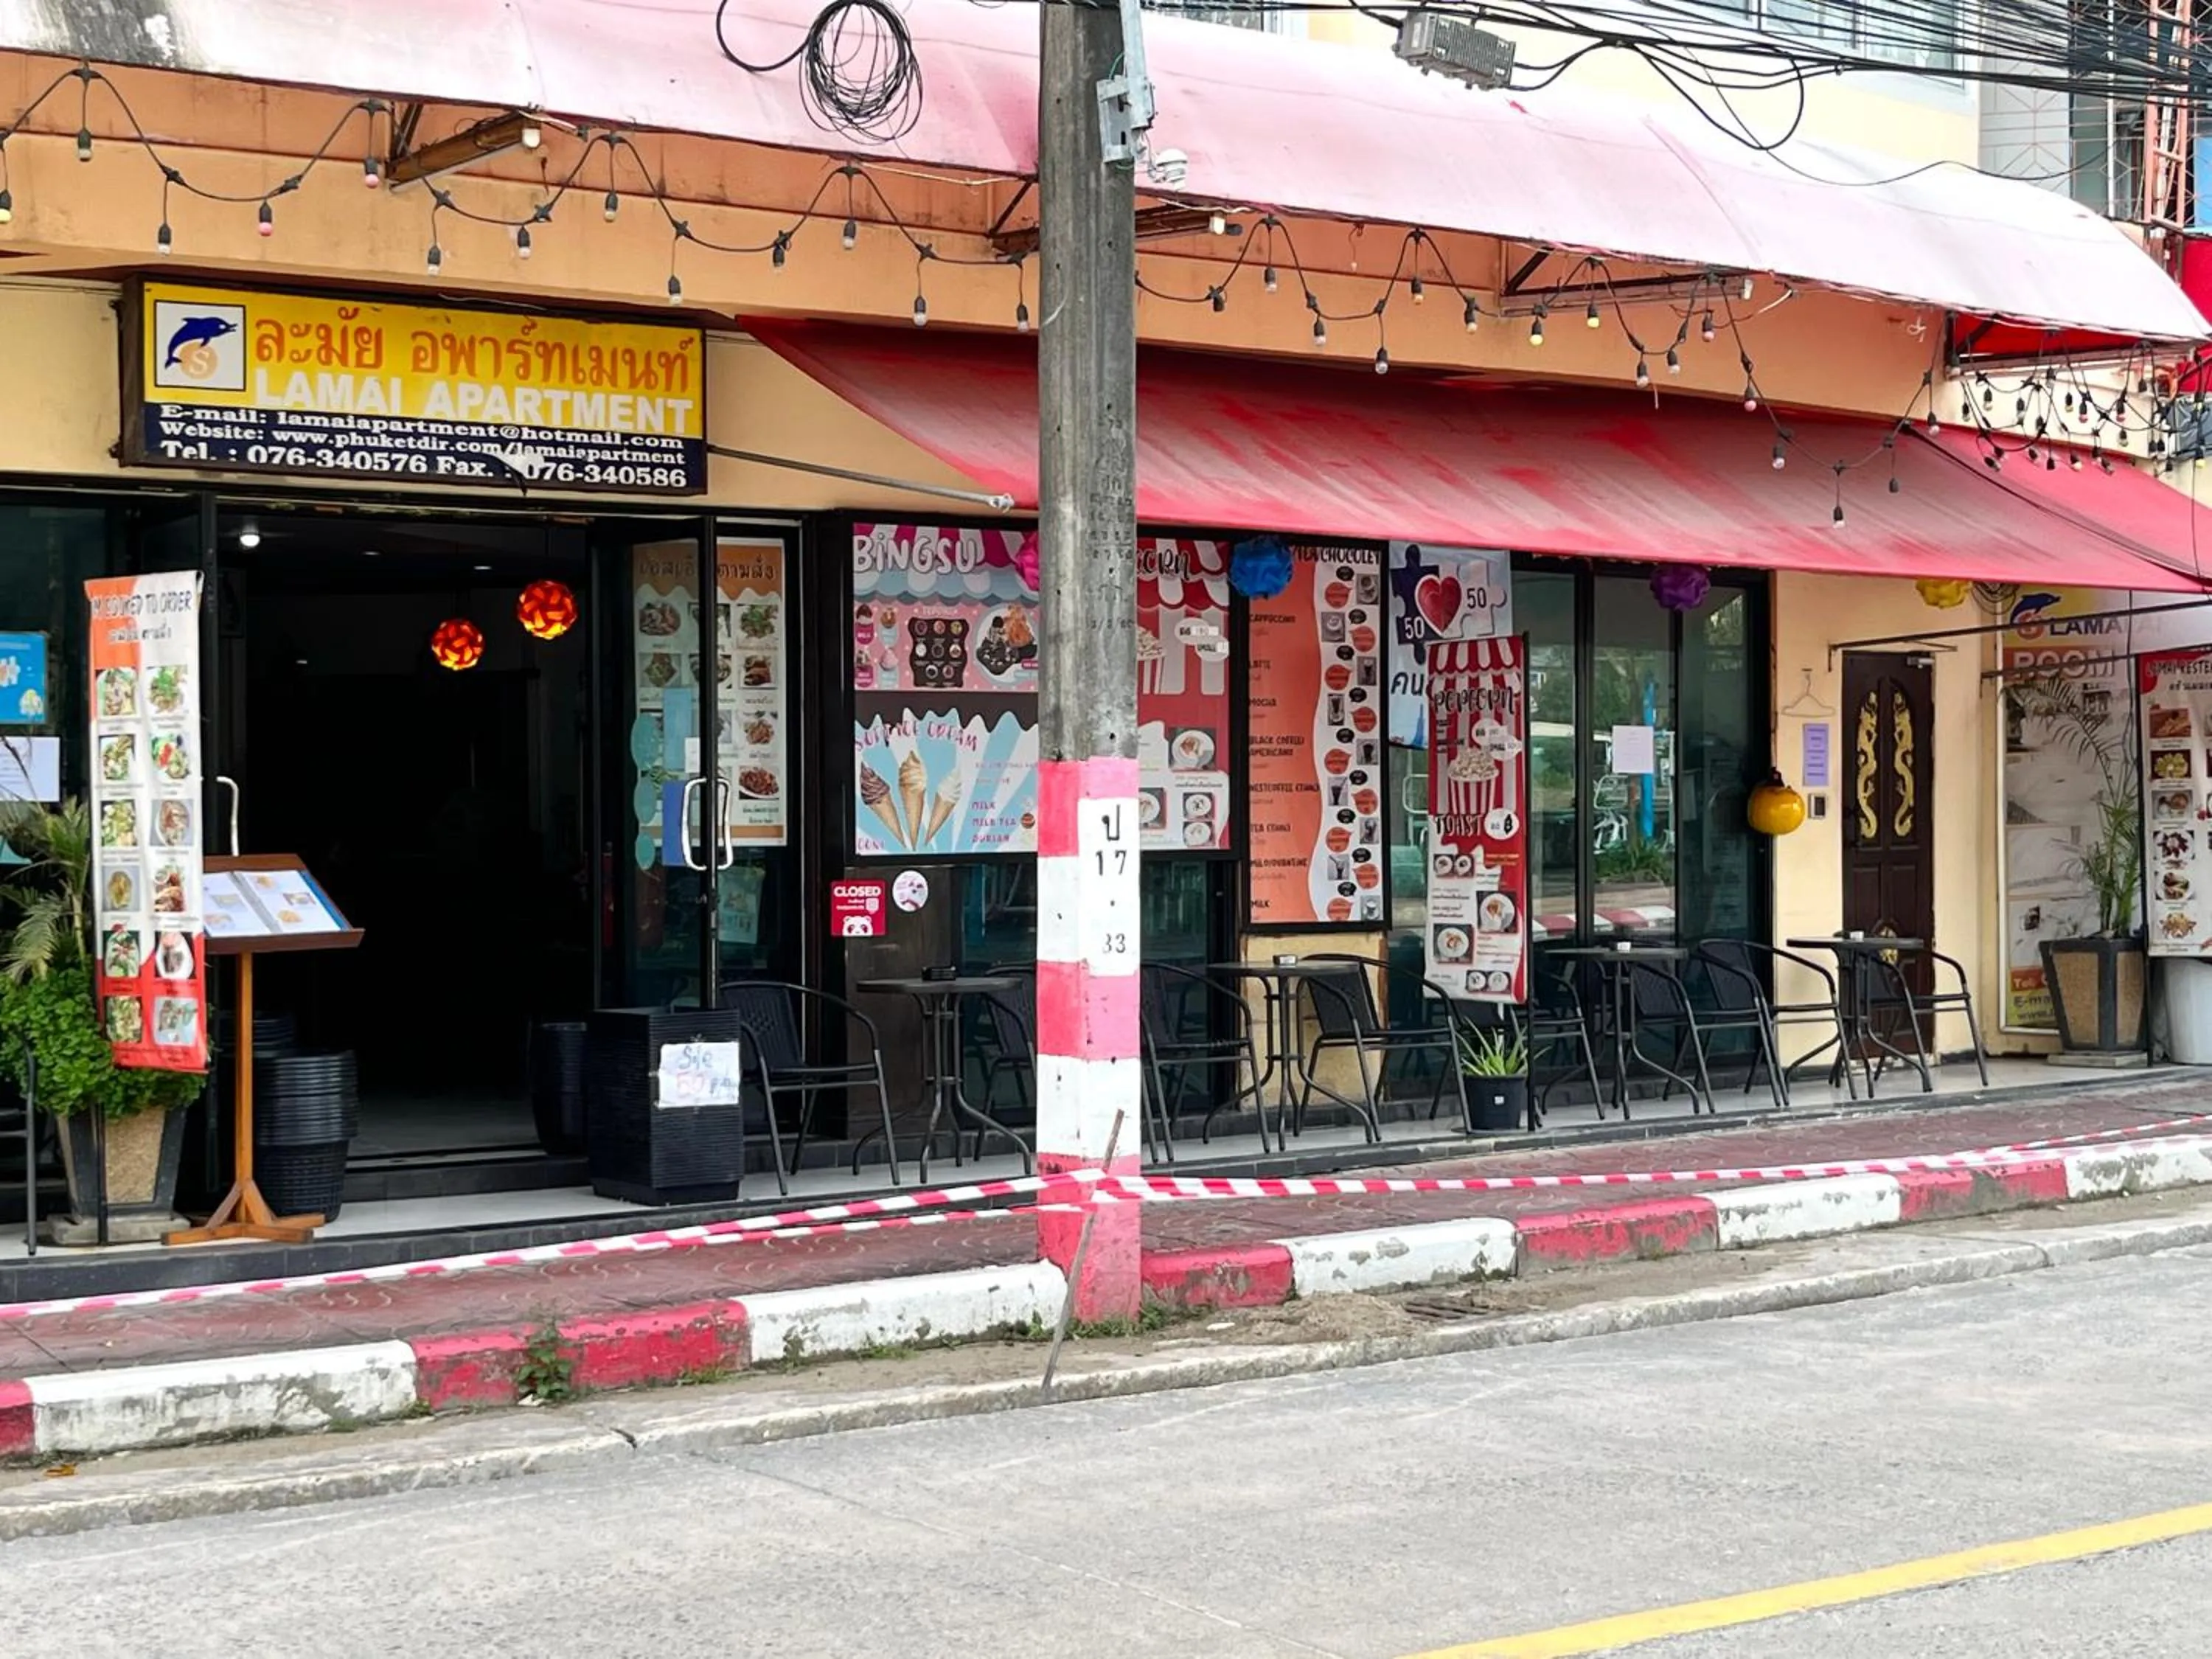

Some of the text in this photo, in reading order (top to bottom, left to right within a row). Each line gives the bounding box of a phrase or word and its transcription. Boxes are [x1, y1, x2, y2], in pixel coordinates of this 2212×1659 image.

[256, 306, 695, 392] ละมัย อพาร์ทเมนท์
[256, 368, 694, 437] LAMAI APARTMENT
[159, 405, 684, 448] E-mail: lamaiapartment@hotmail.com
[159, 420, 264, 441] Website:
[159, 440, 217, 461] Tel.
[246, 445, 427, 473] 076-340576
[436, 456, 494, 477] Fax.
[524, 462, 687, 487] 076-340586
[160, 590, 192, 613] ORDER
[1467, 587, 1487, 609] 50
[1404, 616, 1425, 639] 50
[1436, 813, 1484, 837] TOAST
[1096, 849, 1127, 876] 17
[834, 886, 881, 897] CLOSED
